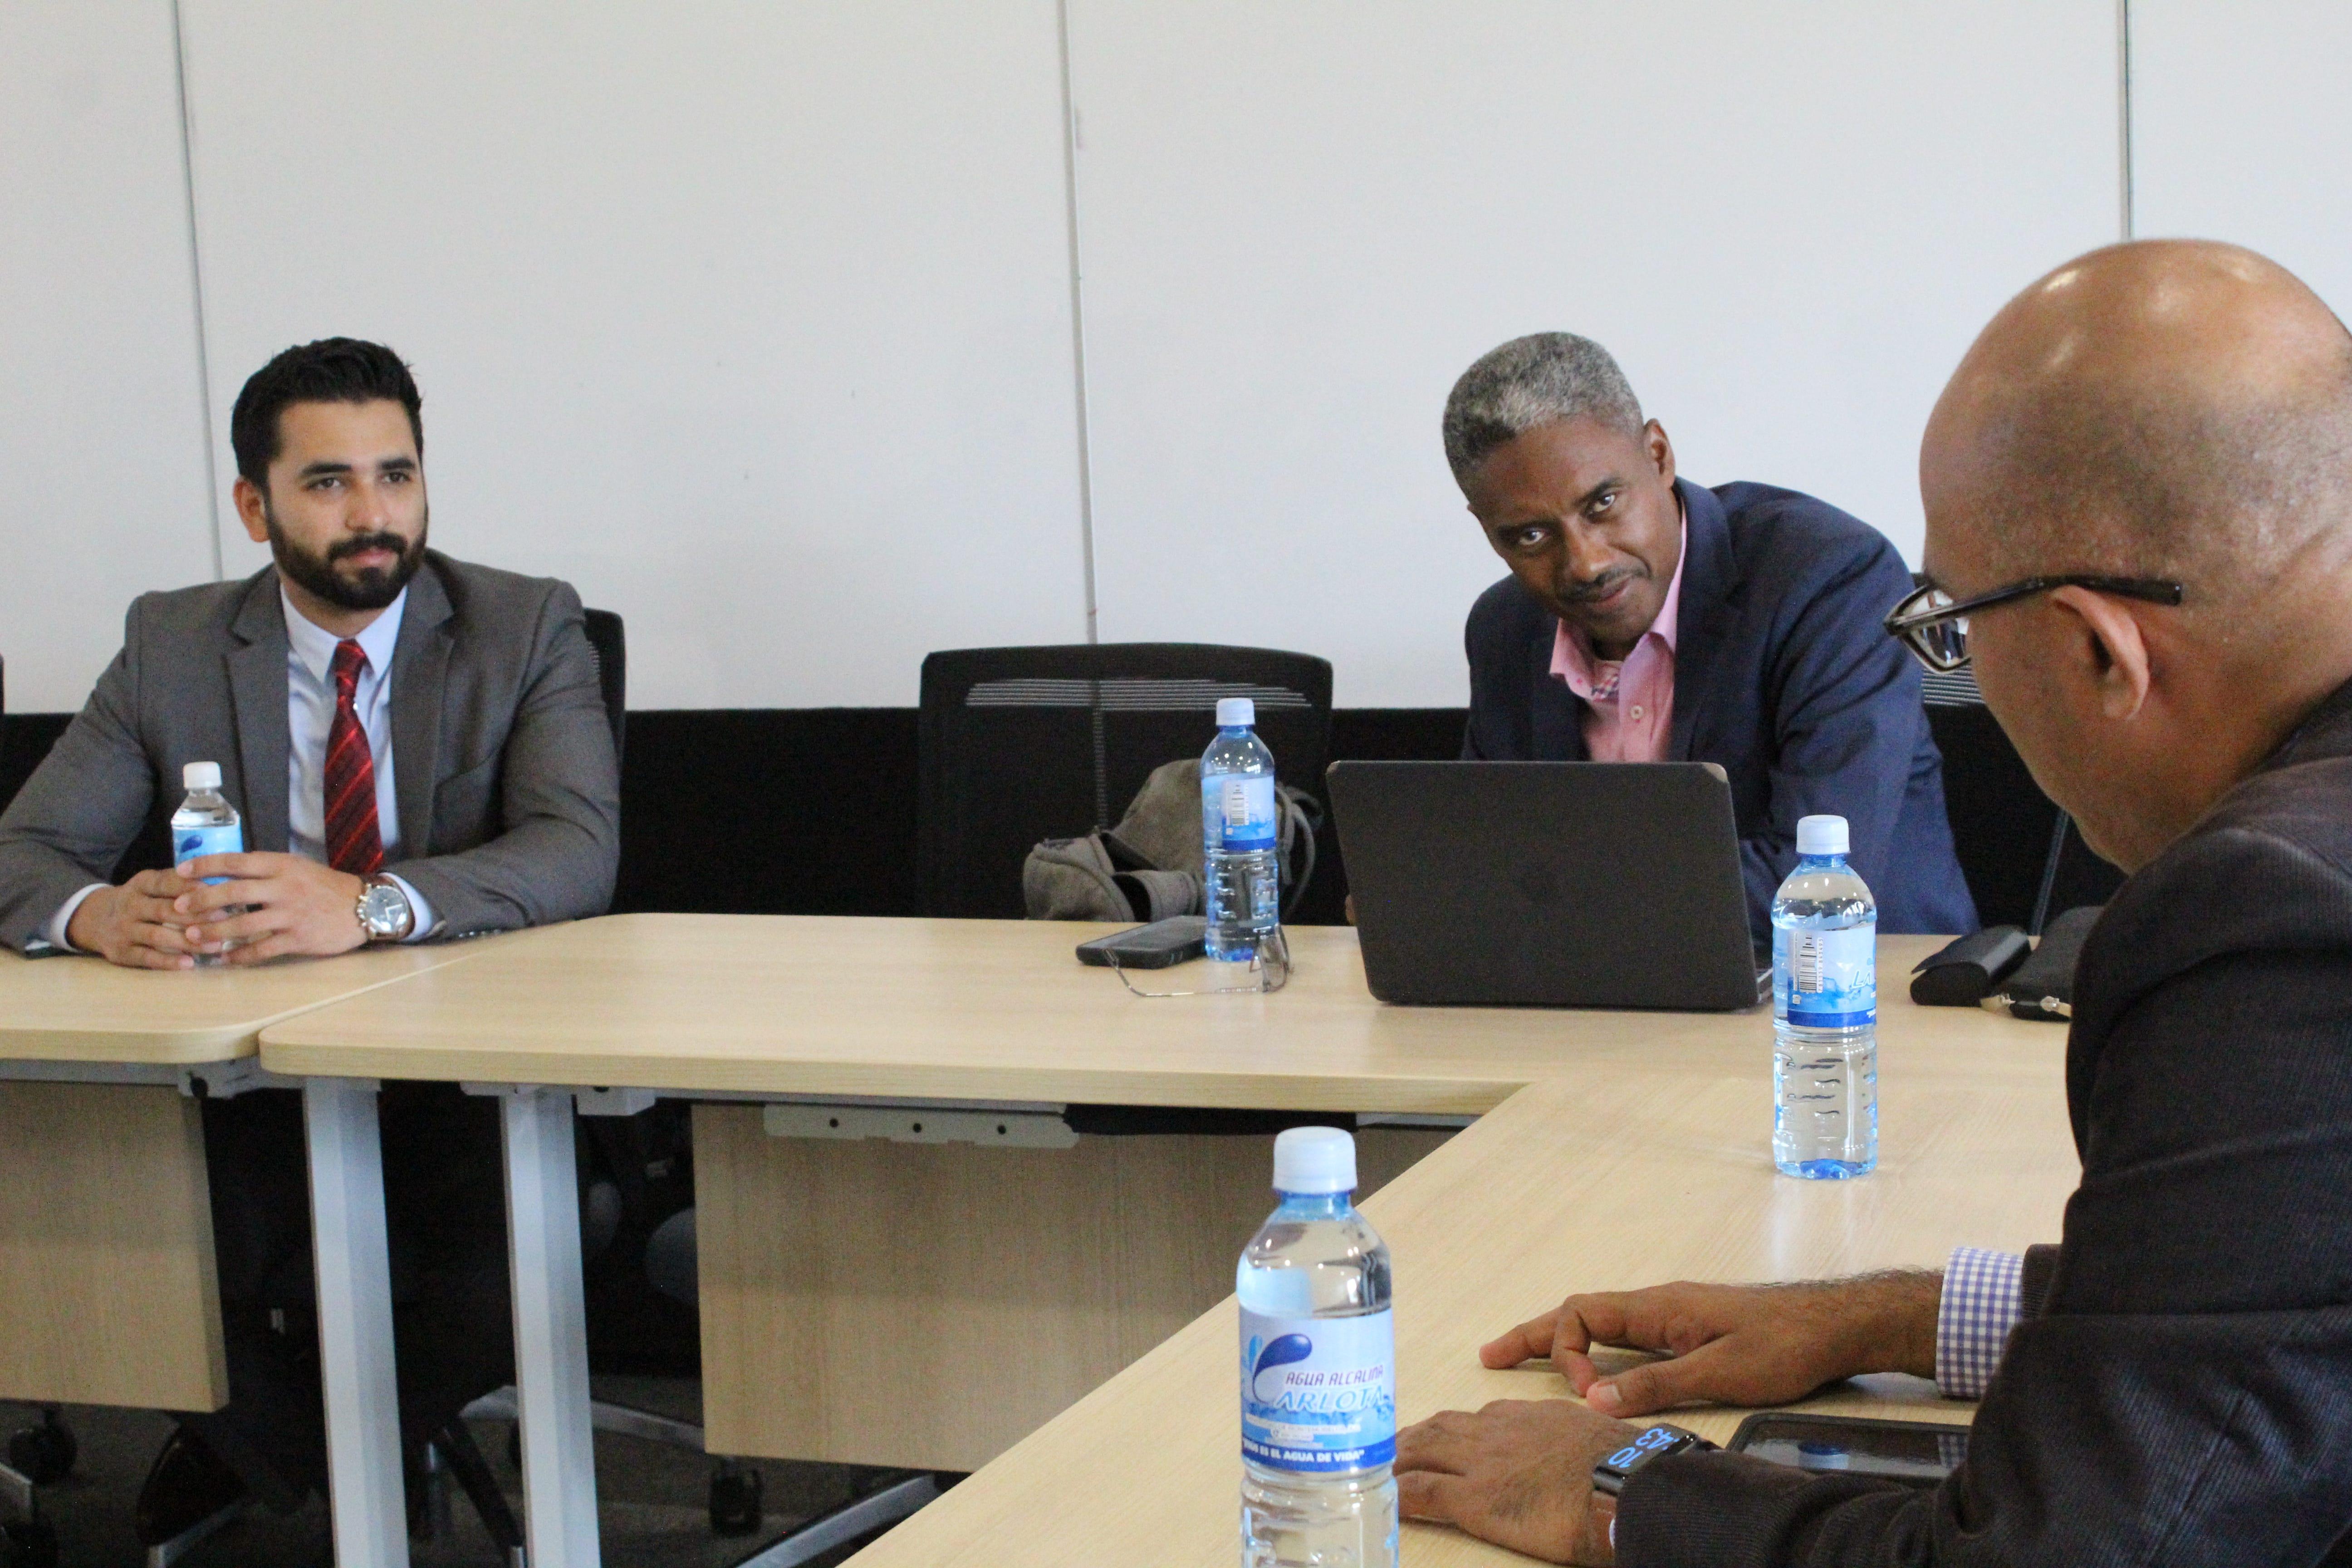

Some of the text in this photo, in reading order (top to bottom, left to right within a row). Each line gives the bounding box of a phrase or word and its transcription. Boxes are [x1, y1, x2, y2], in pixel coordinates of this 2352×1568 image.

[1852, 970, 1870, 987] LA
[1286, 1365, 1383, 1386] AGUA ALCALINA
[1283, 1450, 1315, 1462] AGUA
[1316, 1452, 1332, 1463] DE
